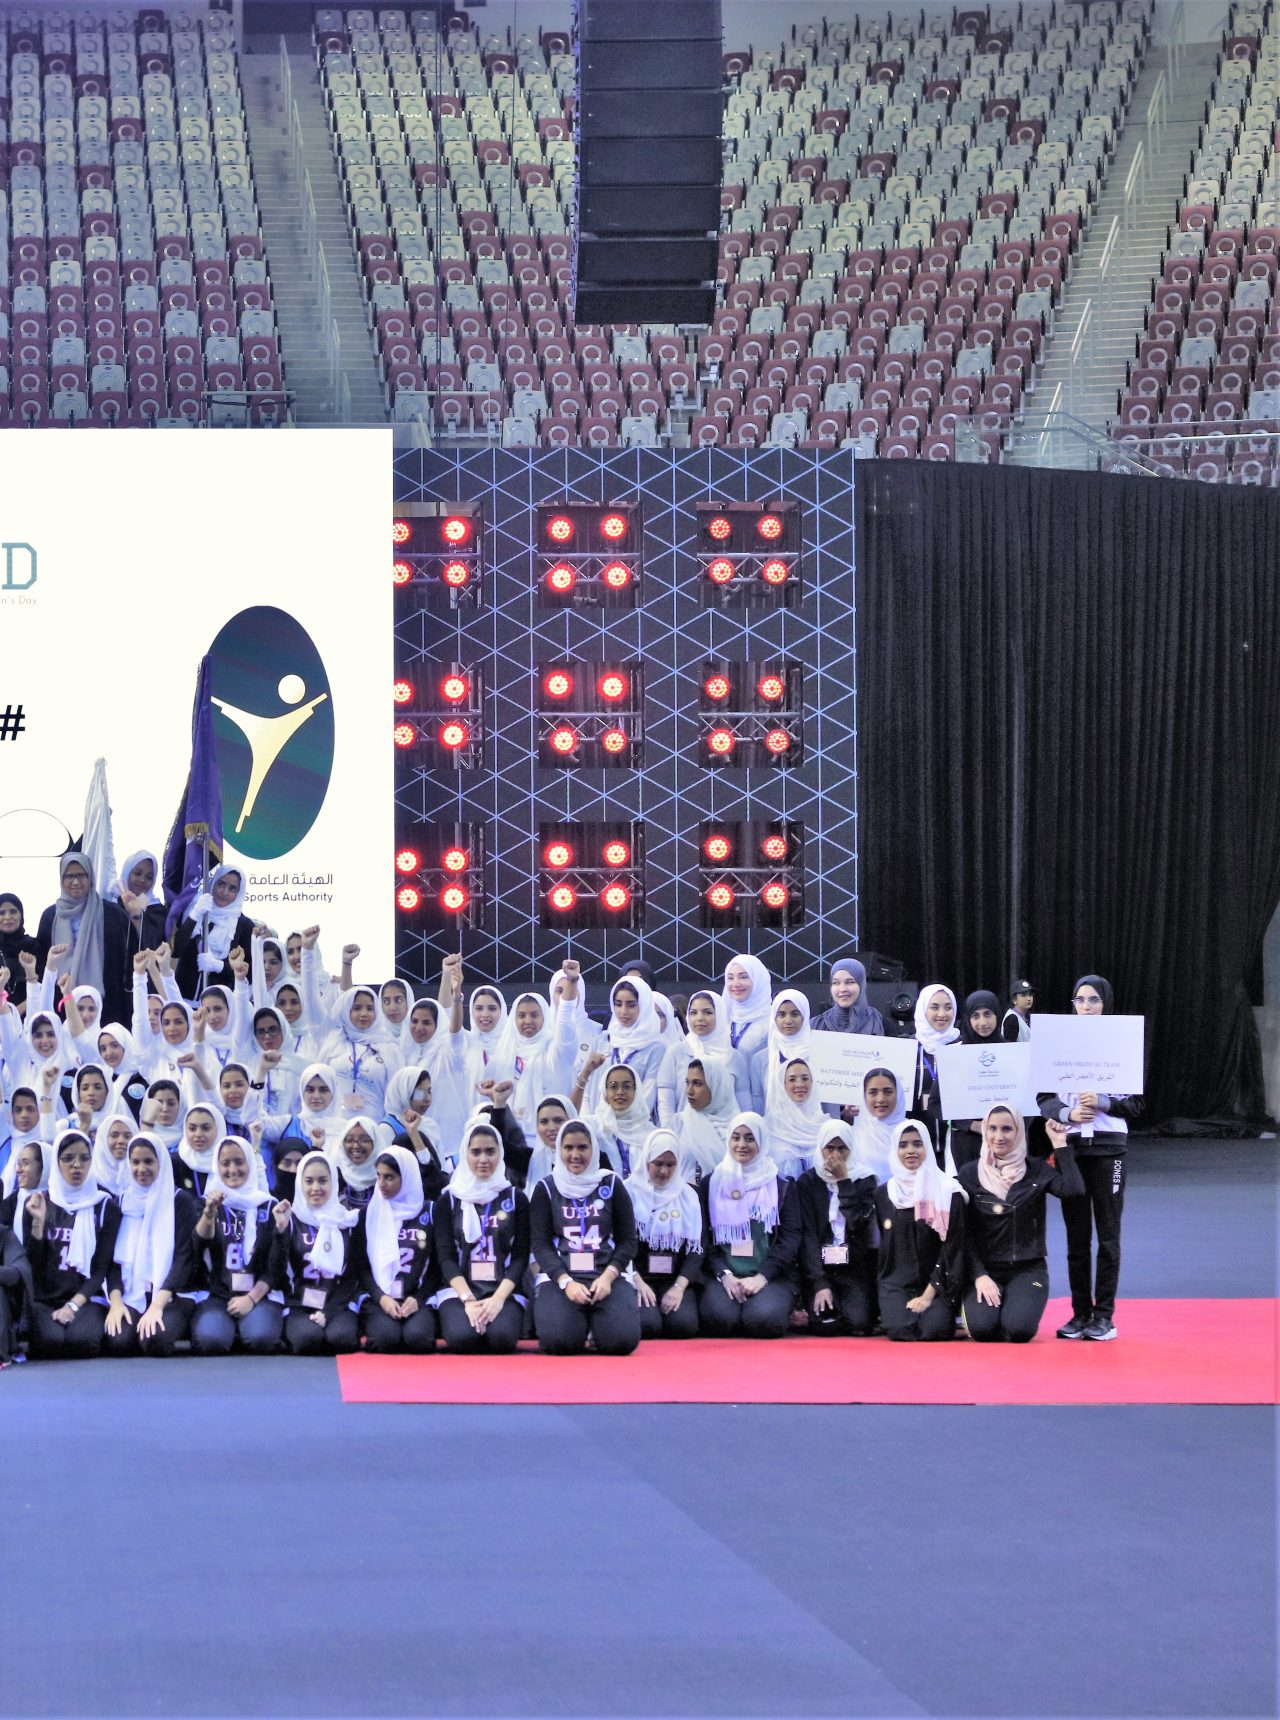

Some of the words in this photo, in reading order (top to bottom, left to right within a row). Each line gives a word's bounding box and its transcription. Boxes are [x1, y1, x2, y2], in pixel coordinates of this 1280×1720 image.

[18, 595, 37, 606] Day
[249, 873, 288, 885] العامة
[292, 872, 333, 888] الهيئة
[244, 892, 279, 903] Sports
[282, 892, 333, 903] Authority
[562, 1204, 600, 1219] UBT
[48, 1227, 74, 1242] UB
[399, 1228, 418, 1241] BT
[563, 1225, 602, 1250] 54
